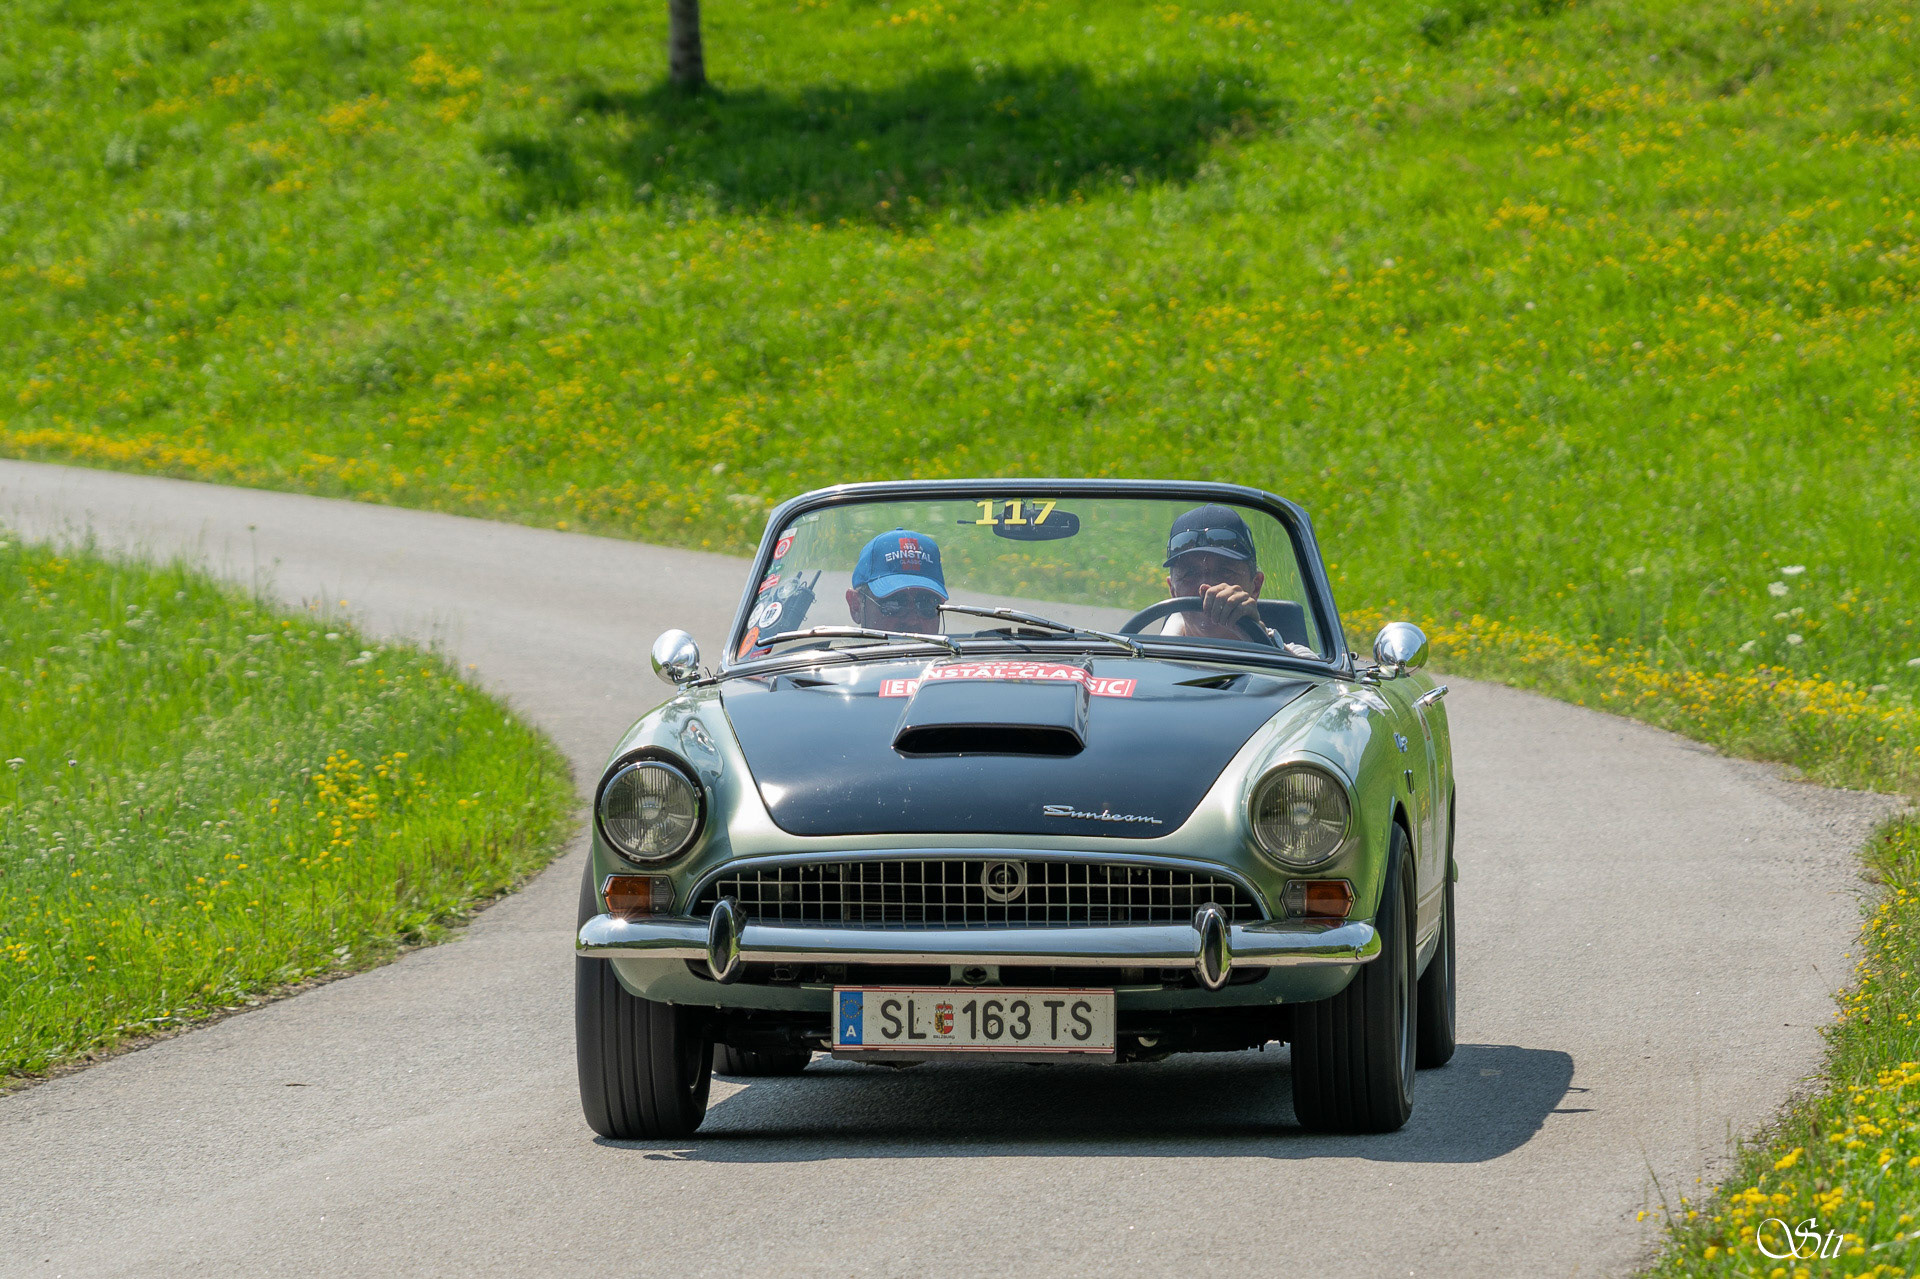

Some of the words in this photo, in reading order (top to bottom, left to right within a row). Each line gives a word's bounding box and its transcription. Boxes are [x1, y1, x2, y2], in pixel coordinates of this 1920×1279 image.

[976, 498, 1057, 525] 117
[884, 550, 934, 564] ENNSTAL
[1043, 804, 1163, 825] Sunbeam
[845, 1024, 857, 1037] A
[880, 999, 927, 1040] SL
[962, 1000, 1032, 1041] 163
[1043, 1000, 1093, 1041] TS
